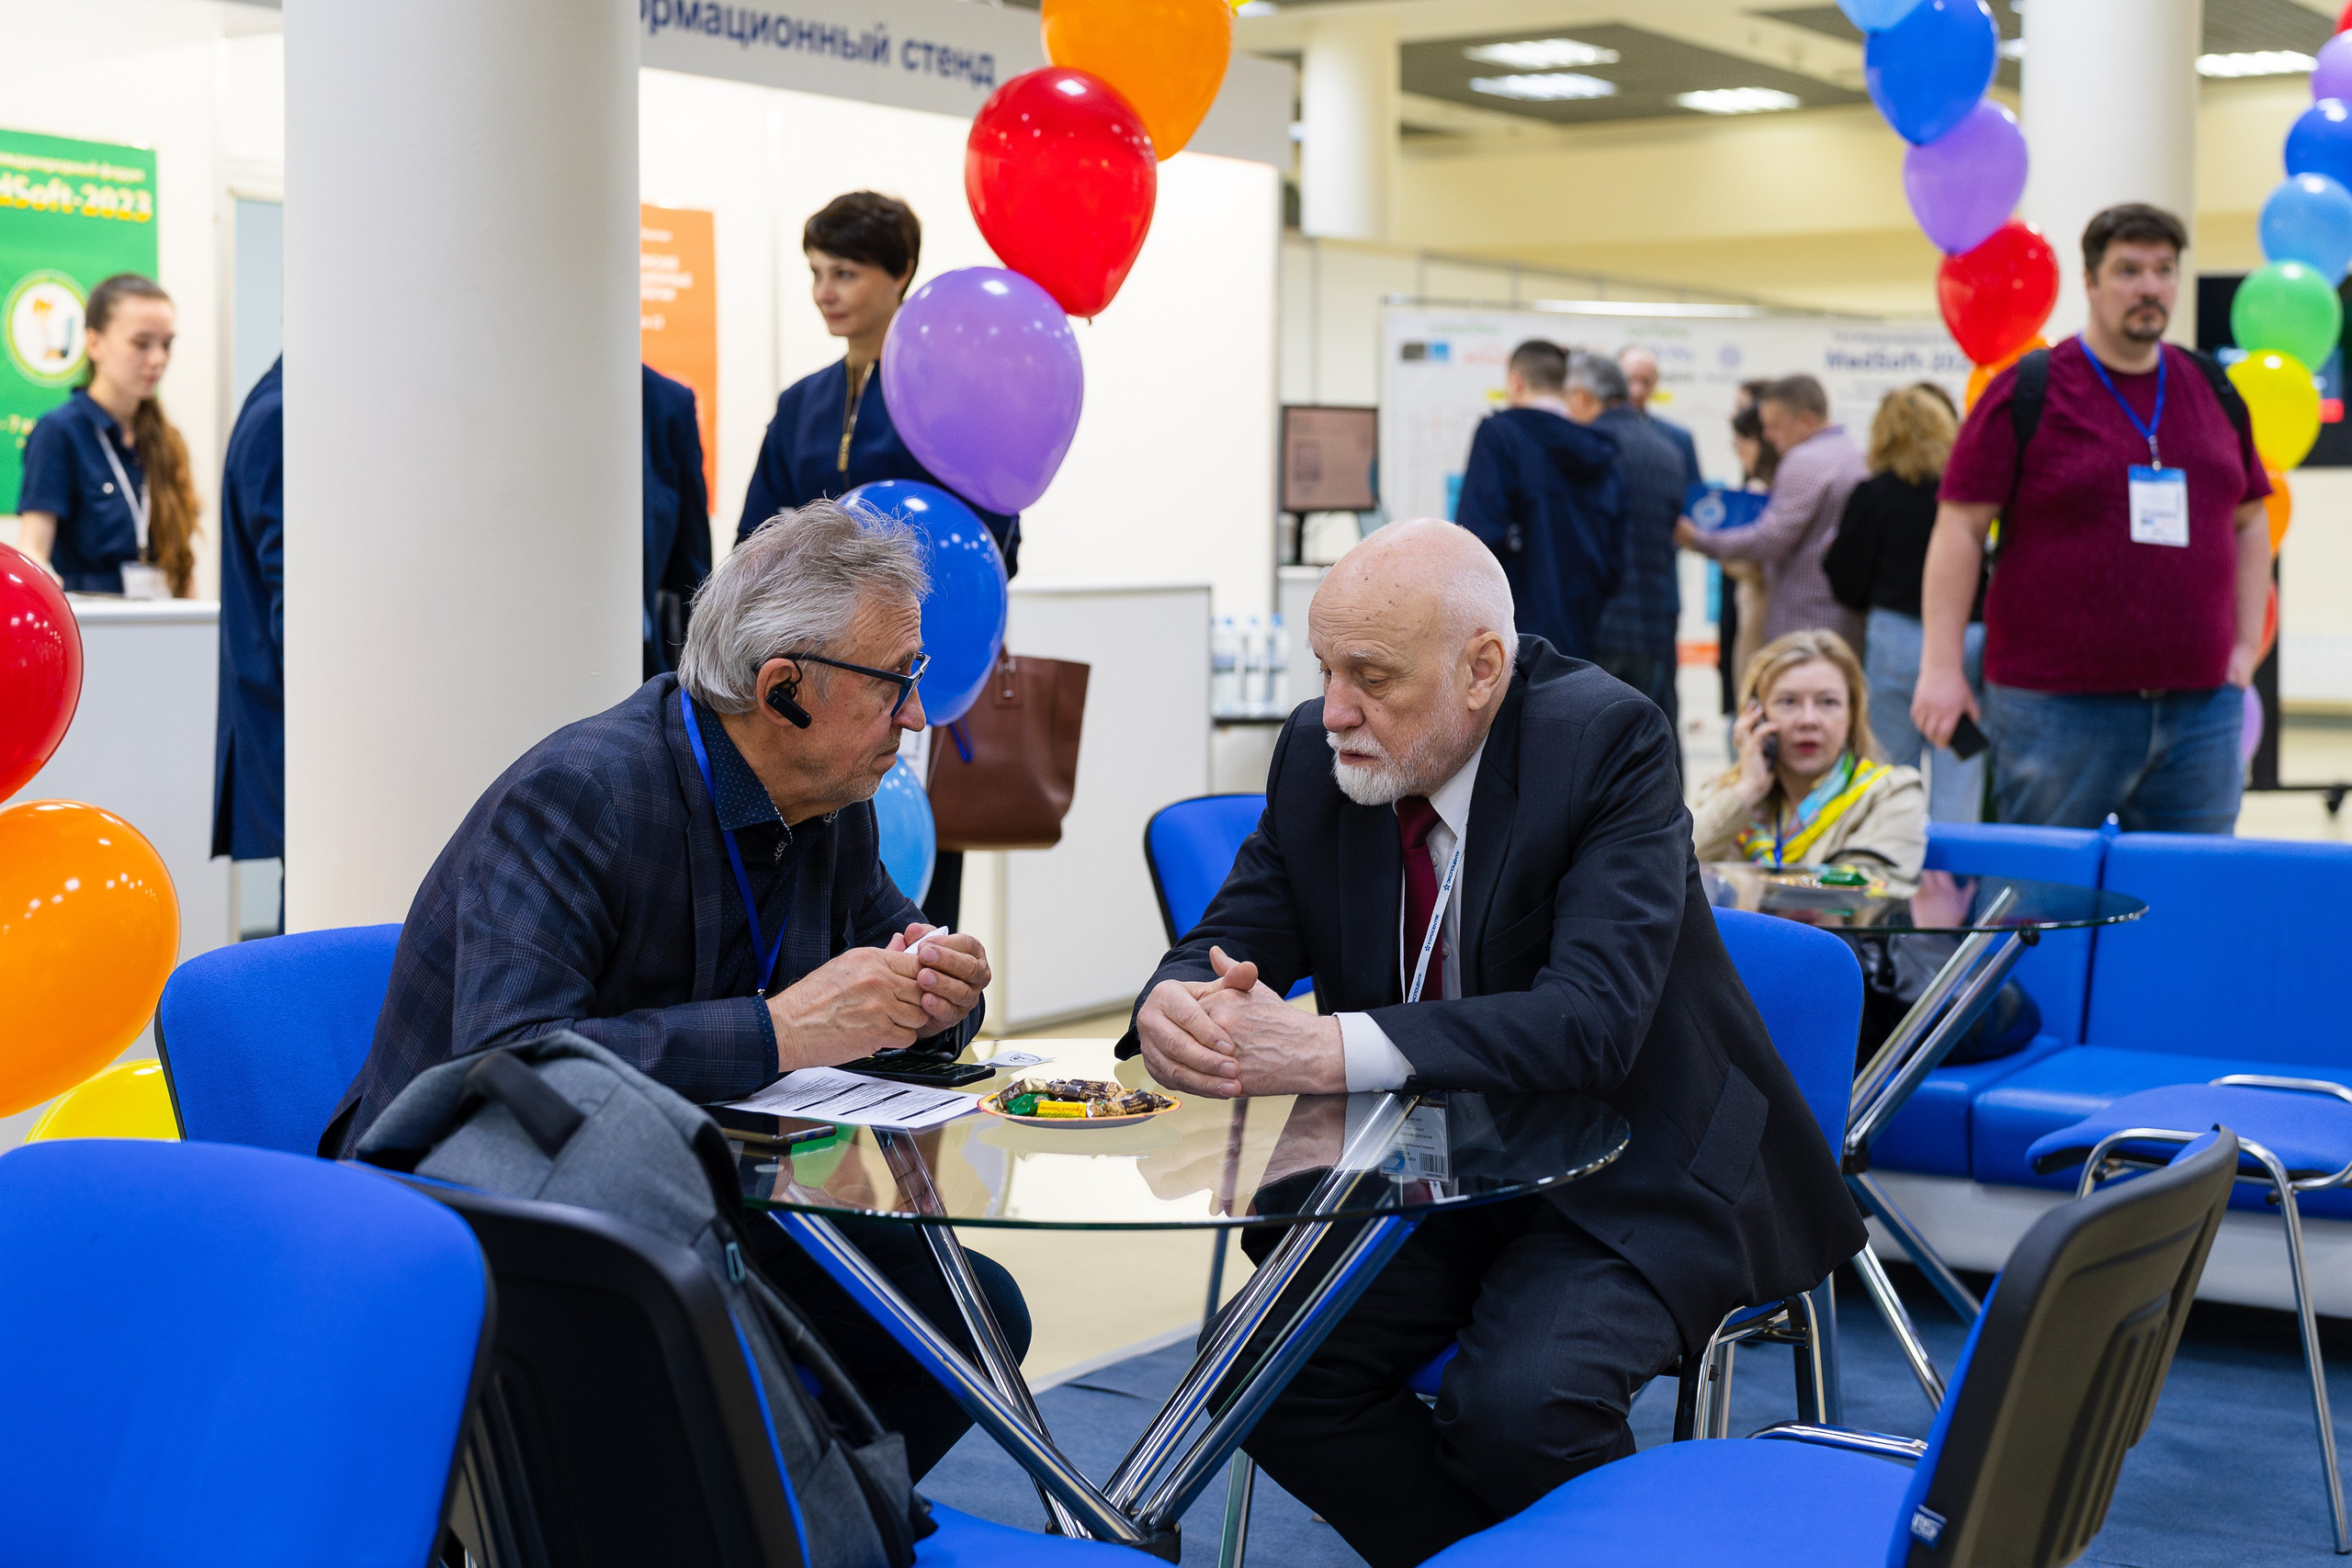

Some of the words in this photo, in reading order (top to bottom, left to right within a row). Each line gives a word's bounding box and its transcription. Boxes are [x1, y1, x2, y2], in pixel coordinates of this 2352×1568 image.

[640, 0, 890, 66] рмационный
[899, 38, 995, 89] стенд
[0, 171, 153, 223] dSoft-2023
[1428, 914, 1440, 945] EXPOCENTRE
[1412, 972, 1422, 1002] КСПОЦЕНТР
